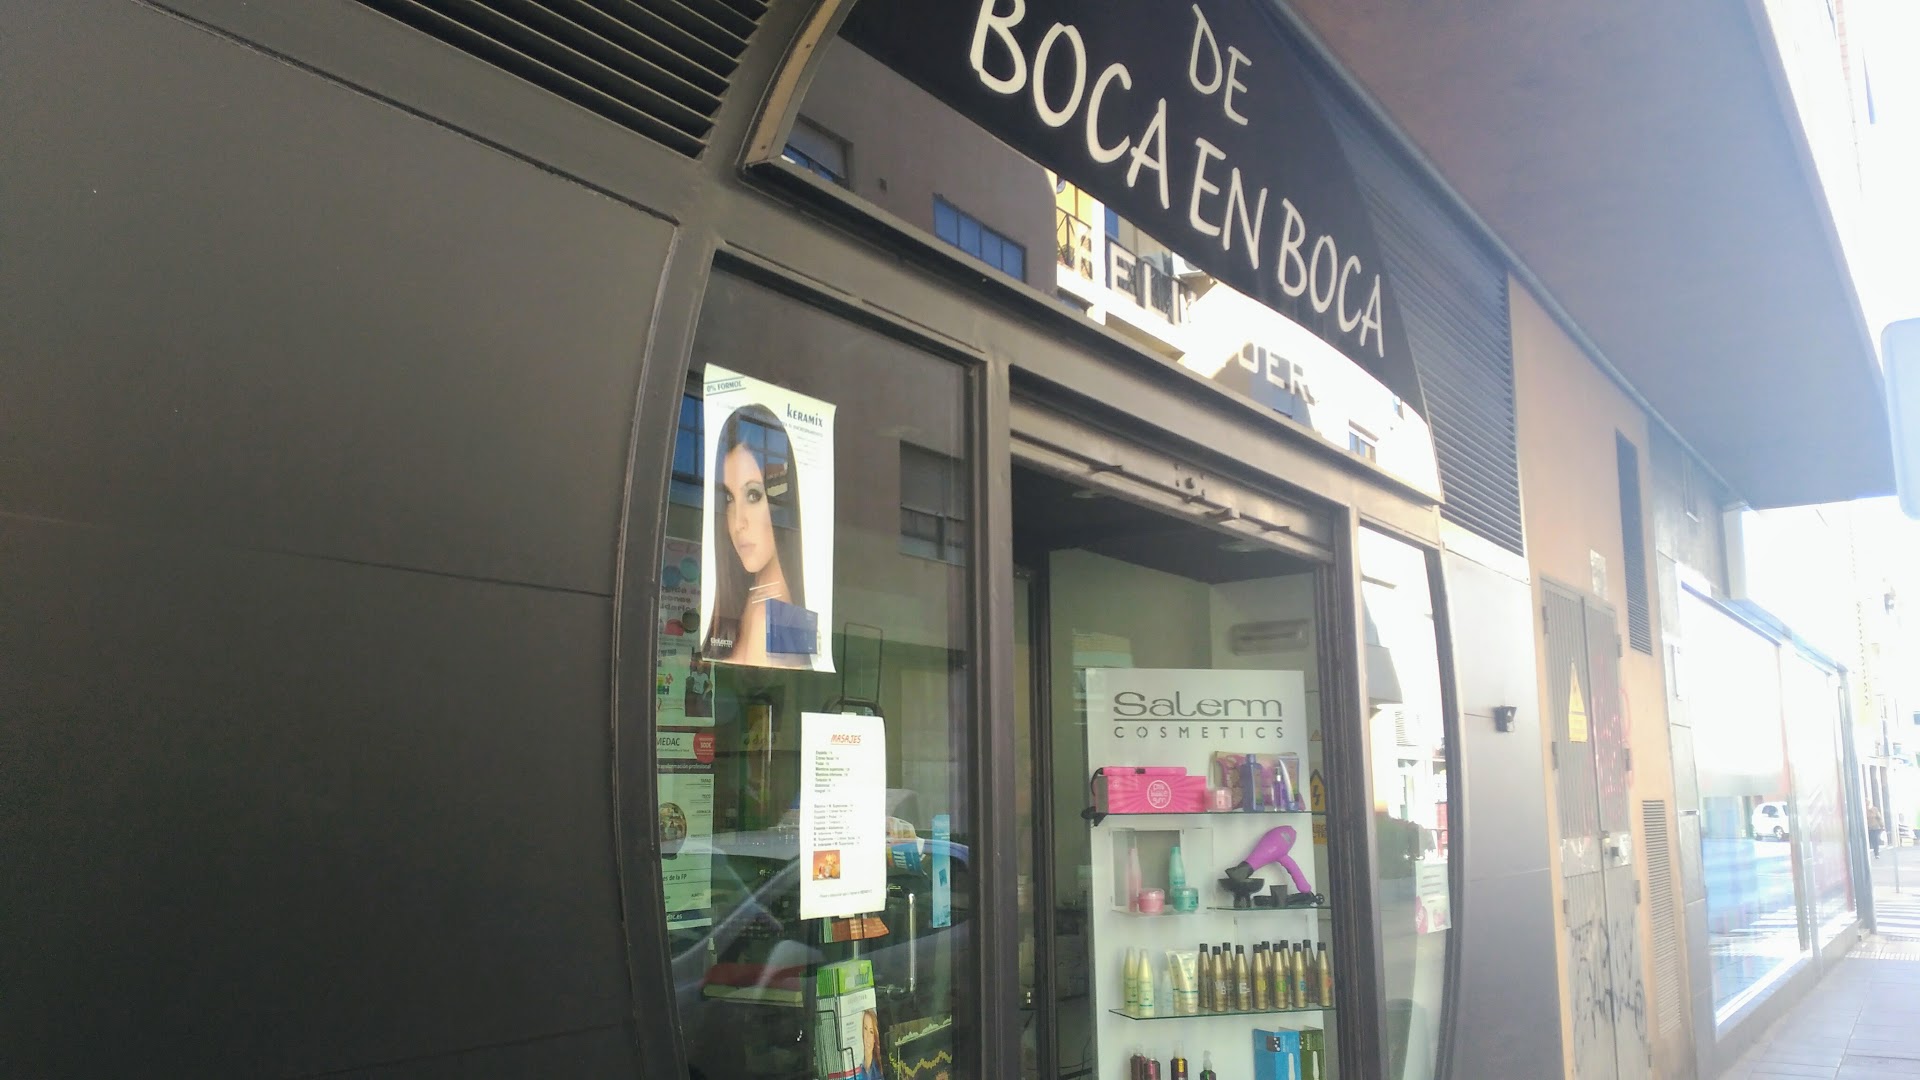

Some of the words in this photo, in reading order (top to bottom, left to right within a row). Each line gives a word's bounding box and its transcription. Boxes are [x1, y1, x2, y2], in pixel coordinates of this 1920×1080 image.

[1189, 3, 1252, 126] DE
[970, 0, 1171, 209] BOCA
[1189, 137, 1268, 270] EN
[1277, 197, 1384, 358] BOCA
[717, 380, 742, 391] FORMOL
[1113, 691, 1283, 717] Salerm
[1113, 726, 1284, 739] COSMETICS
